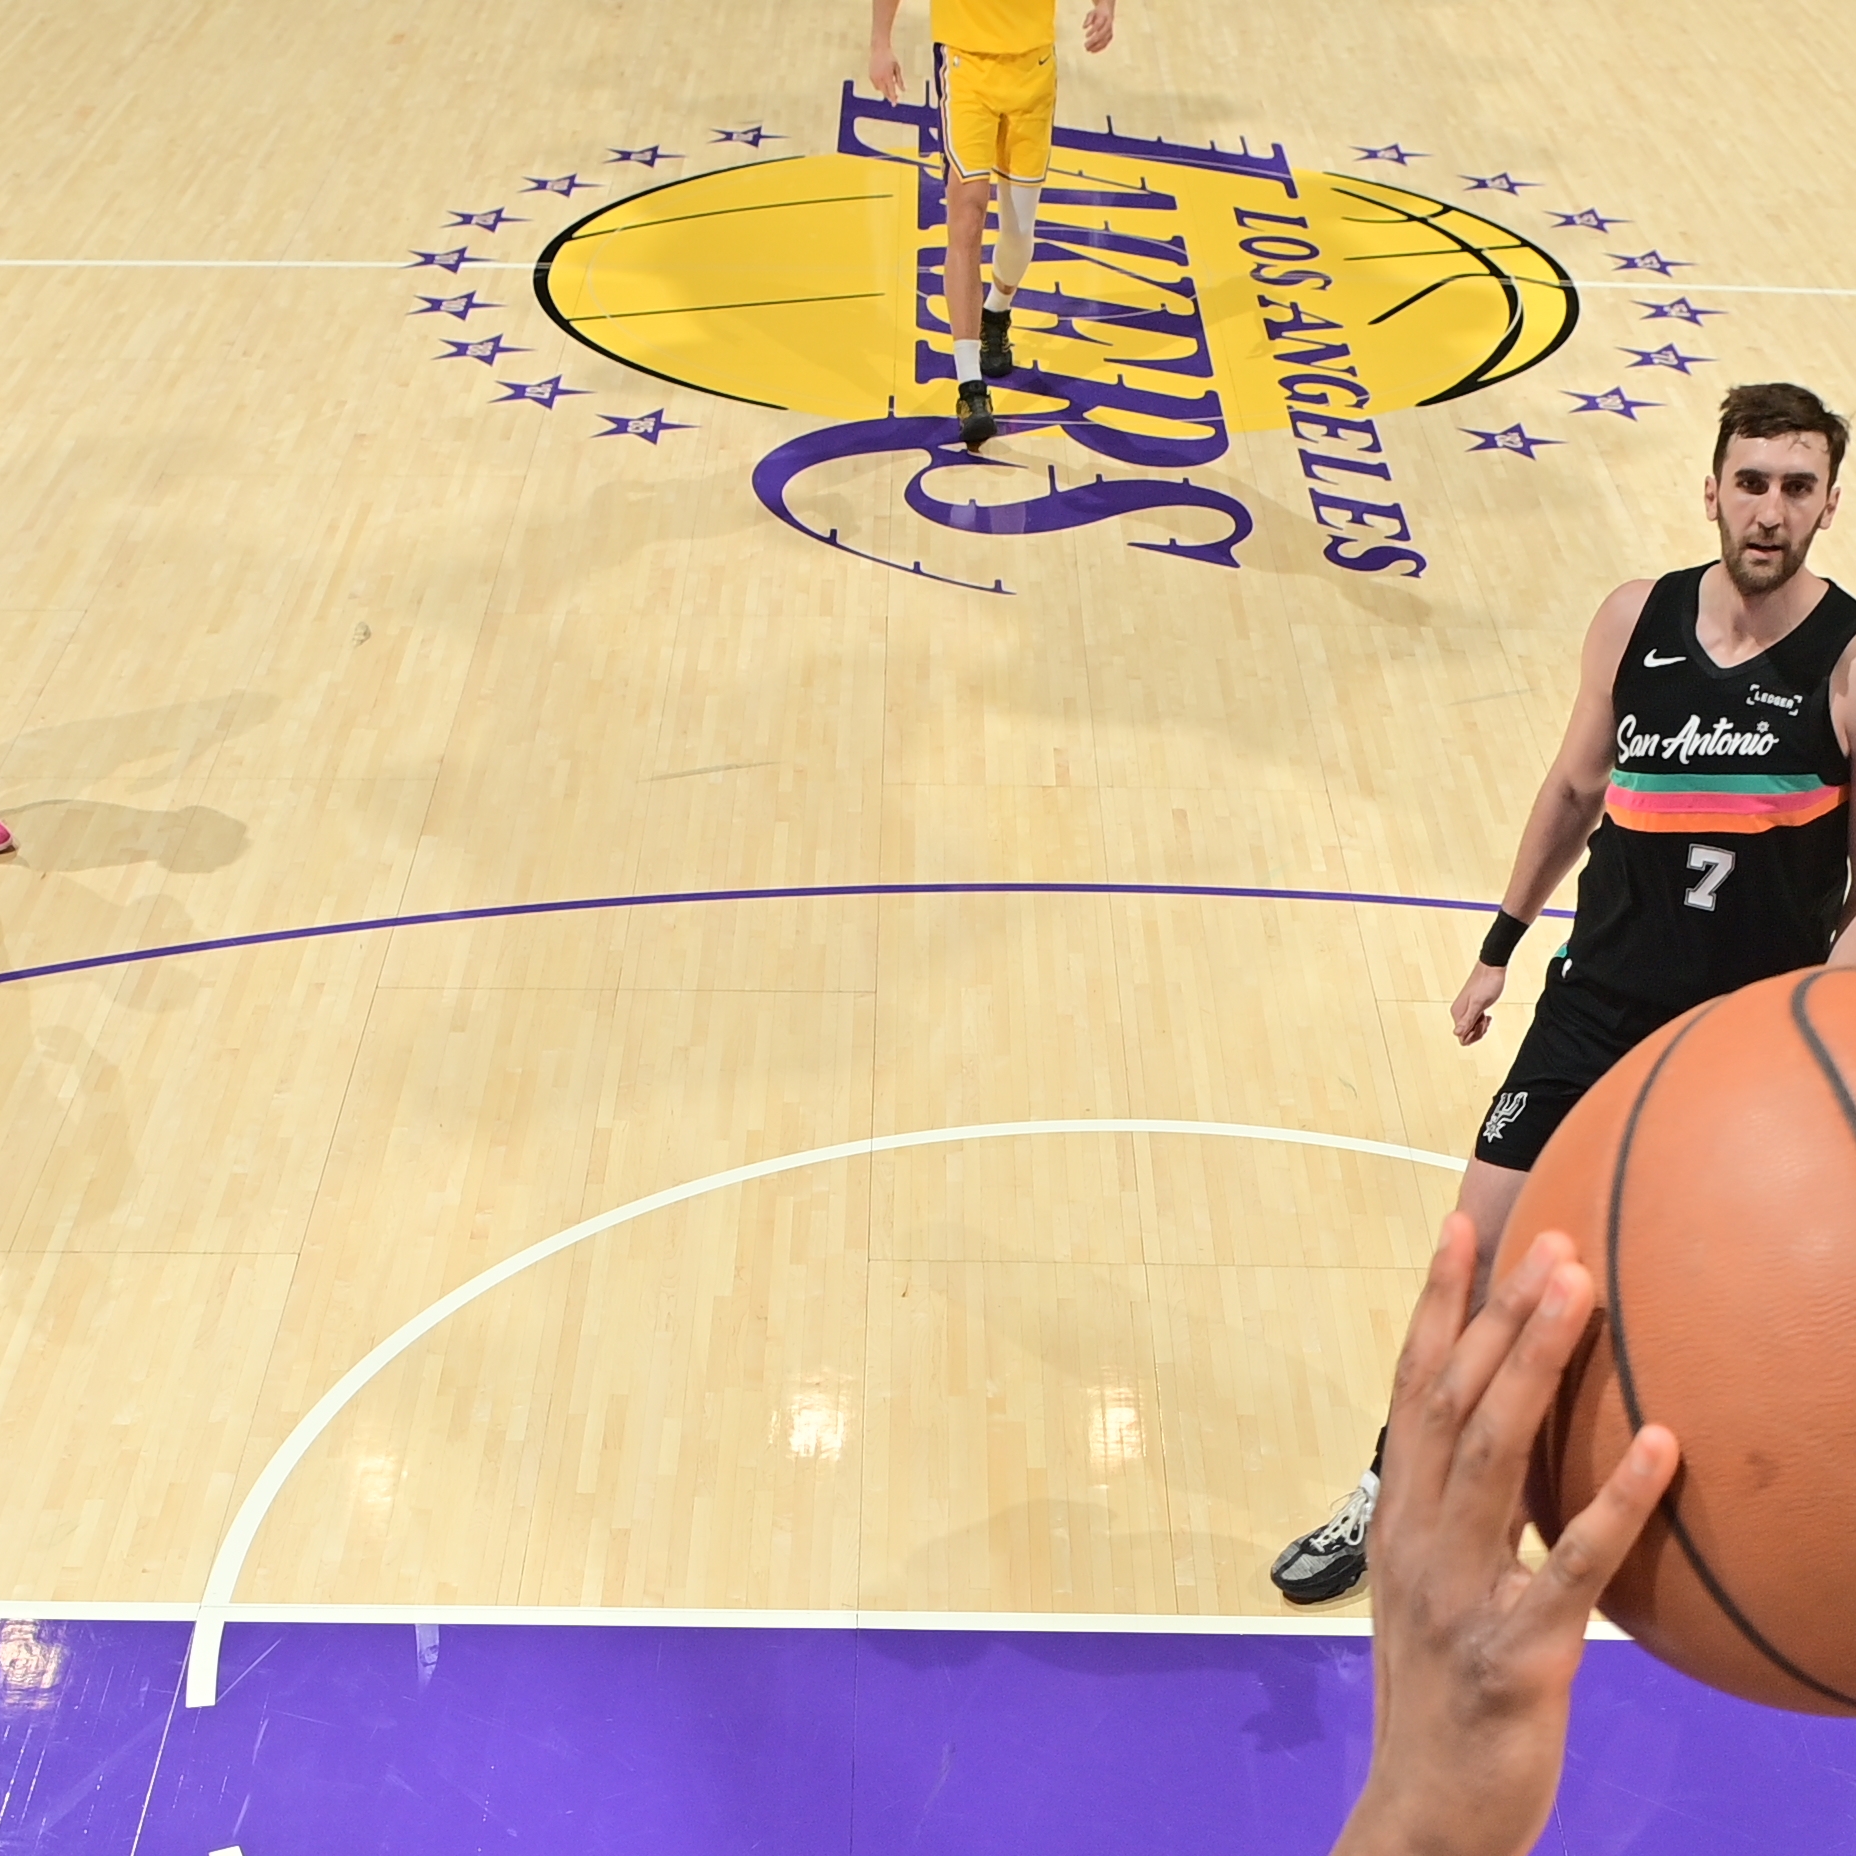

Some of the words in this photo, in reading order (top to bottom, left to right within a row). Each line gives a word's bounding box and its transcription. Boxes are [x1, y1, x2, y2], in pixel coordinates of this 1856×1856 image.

[1232, 206, 1333, 292] LOS
[1256, 294, 1428, 579] ANGELES
[1753, 690, 1795, 710] LEDGER
[1616, 713, 1661, 765] San
[1661, 713, 1780, 765] Antonio
[1683, 842, 1737, 912] 7
